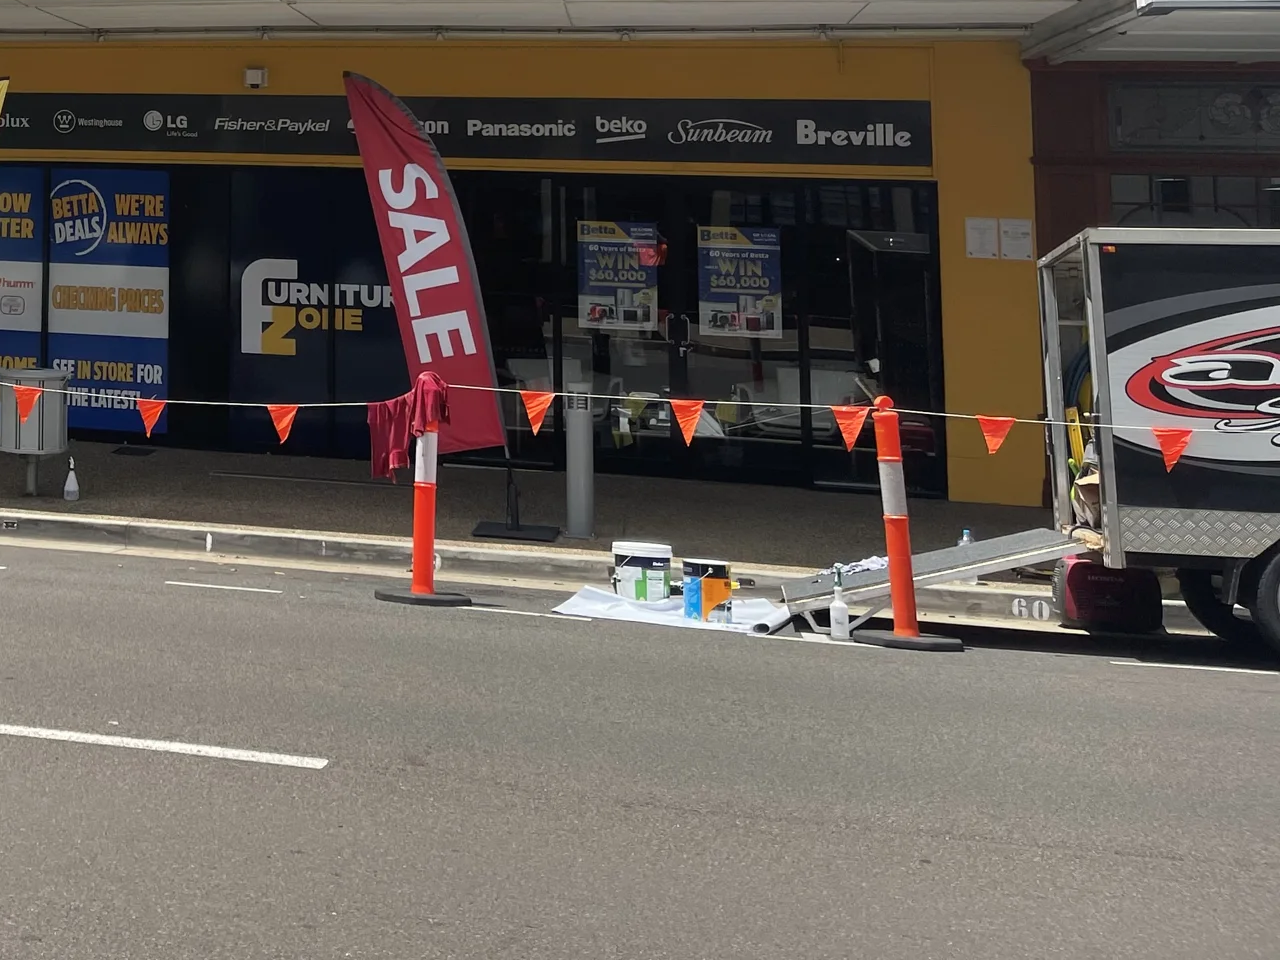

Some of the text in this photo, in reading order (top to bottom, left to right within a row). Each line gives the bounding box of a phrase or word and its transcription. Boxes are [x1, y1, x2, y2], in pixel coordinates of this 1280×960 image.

[77, 117, 123, 127] Westinghouse
[167, 116, 188, 128] LG
[214, 118, 331, 135] Fisher&Paykel
[467, 120, 576, 137] Panasonic
[596, 116, 647, 133] beko
[667, 120, 773, 144] Sunbeam
[796, 119, 912, 147] Breville
[52, 192, 99, 220] BETTA
[114, 193, 164, 217] WE'RE
[54, 216, 100, 244] DEALS
[106, 221, 168, 245] ALWAYS
[580, 223, 616, 236] Betta
[700, 229, 737, 242] Betta
[378, 163, 477, 364] SALE
[595, 251, 641, 270] WIN
[717, 257, 763, 277] WIN
[588, 270, 646, 282] $60,000
[709, 276, 770, 289] $60,000
[52, 284, 116, 312] CHECKING
[117, 287, 165, 315] PRICES
[53, 359, 163, 385] SEE IN STORE FOR
[1011, 597, 1051, 621] 60
